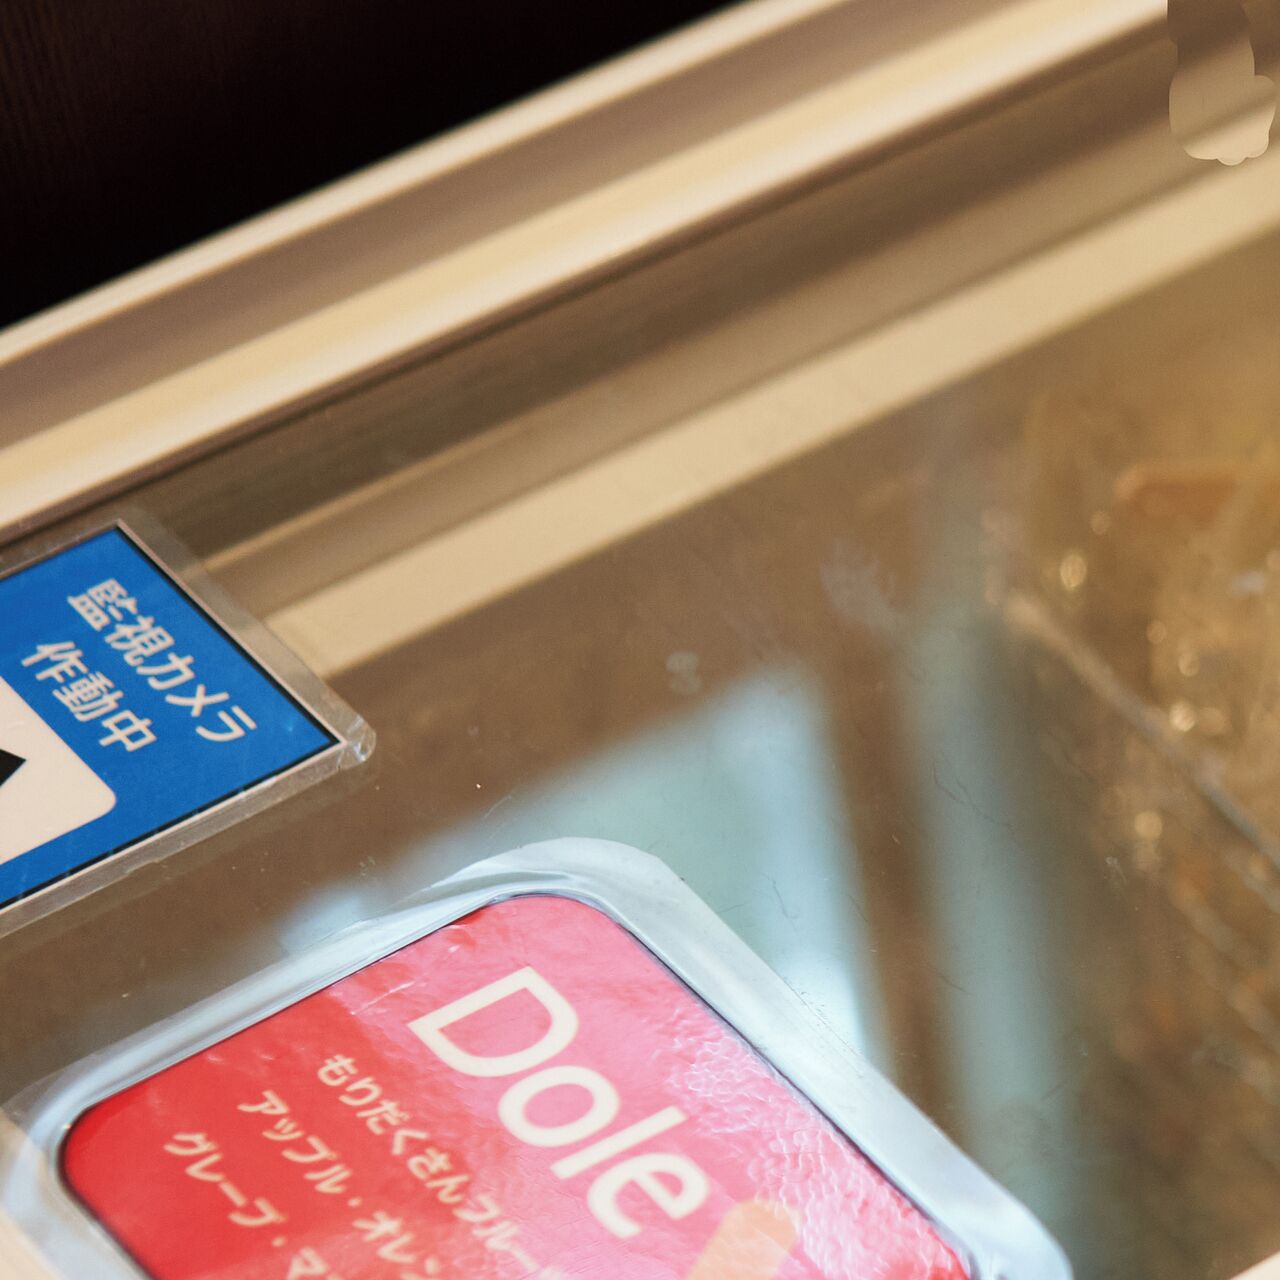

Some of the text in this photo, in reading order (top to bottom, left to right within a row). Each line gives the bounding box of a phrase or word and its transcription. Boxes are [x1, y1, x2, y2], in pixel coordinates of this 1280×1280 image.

[21, 641, 158, 753] 作動中
[67, 578, 257, 743] 監視カメラ
[409, 965, 712, 1240] Dole
